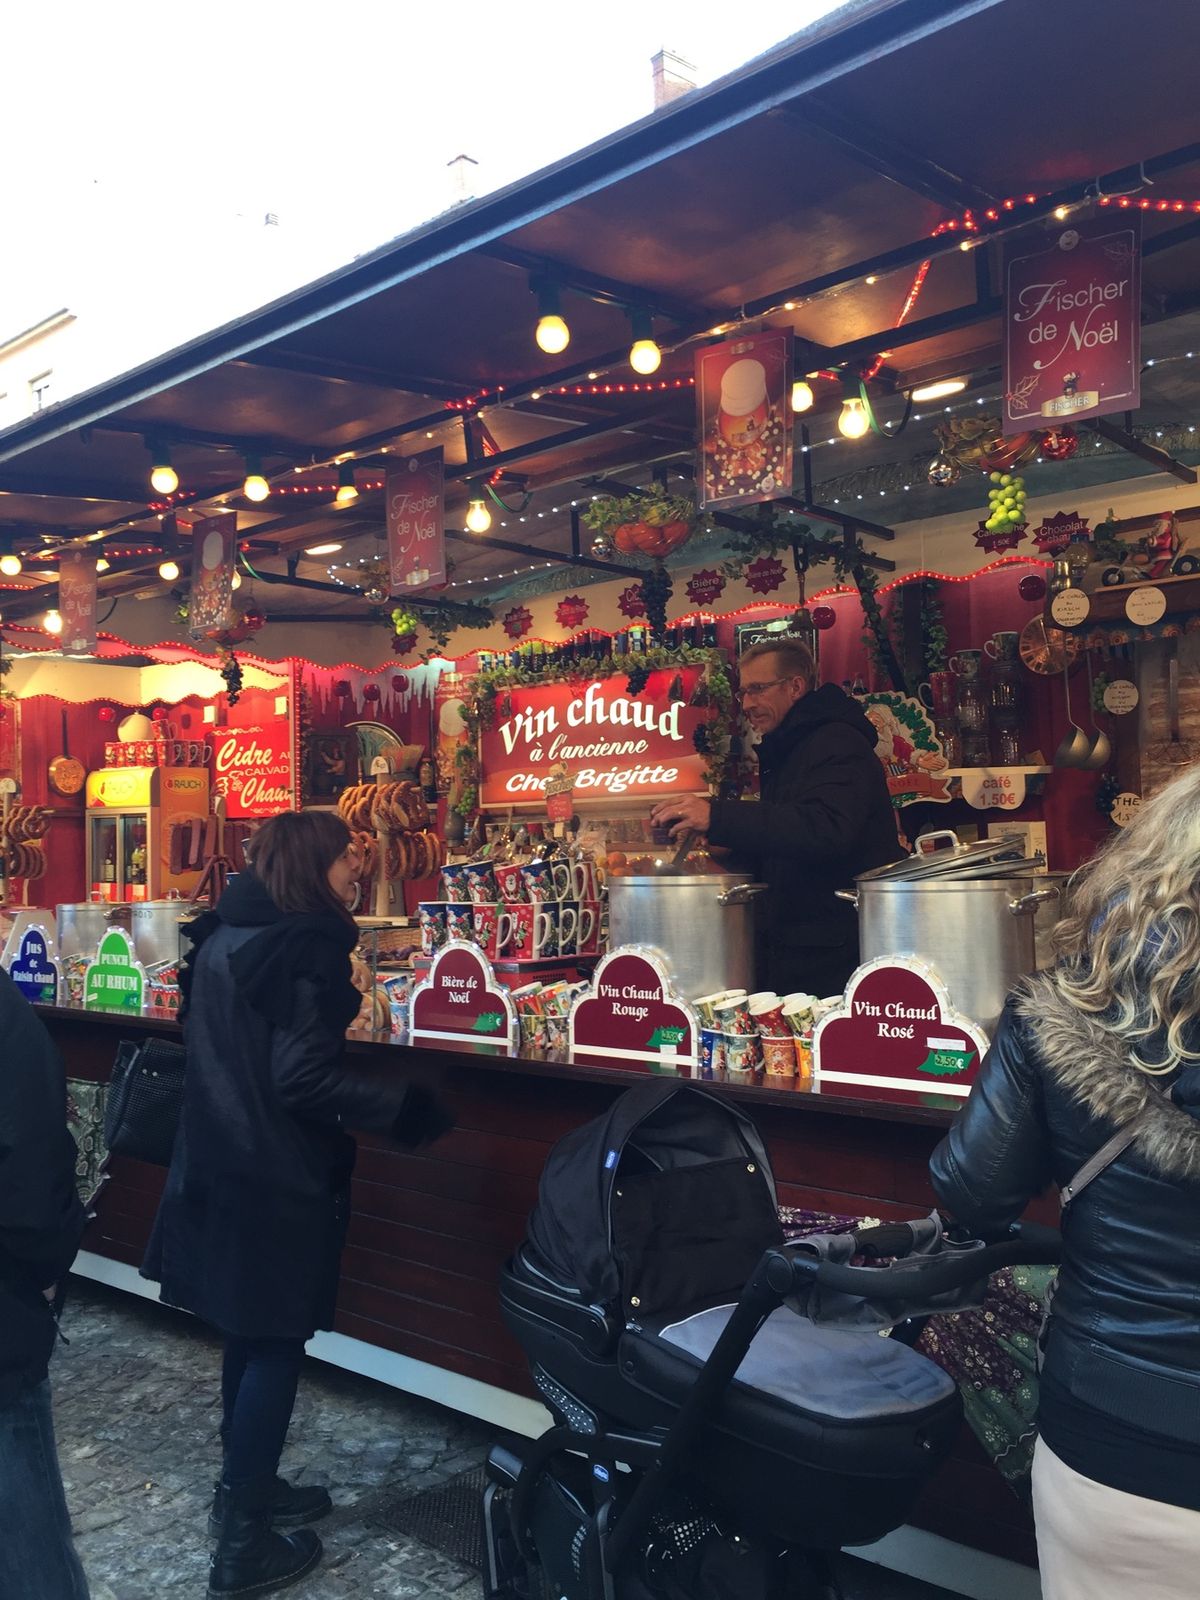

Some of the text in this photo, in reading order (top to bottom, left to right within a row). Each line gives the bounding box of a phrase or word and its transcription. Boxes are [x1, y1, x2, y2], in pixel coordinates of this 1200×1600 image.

[1014, 279, 1129, 322] Fischer
[1028, 303, 1119, 370] de Noël
[391, 493, 439, 520] Fischer
[397, 510, 436, 553] de Noël
[1039, 520, 1084, 536] Chocolat
[1047, 531, 1078, 544] chau
[499, 682, 687, 756] Vin chaud
[216, 738, 273, 772] Cidre
[529, 732, 649, 762] à l'ancienne
[244, 765, 290, 777] CALVAD
[505, 763, 680, 793] Che Brigitte
[174, 779, 201, 789] RAUCH
[982, 775, 1012, 789] café
[980, 792, 1016, 806] 1.50€
[1113, 796, 1140, 806] THE
[25, 941, 43, 956] Jus
[101, 953, 129, 966] PUNCH
[34, 971, 55, 984] chaud
[91, 973, 138, 991] AU RHUM
[441, 975, 478, 989] Bière de
[448, 990, 470, 1005] Noël
[600, 984, 662, 1001] Vin Chaud
[611, 1002, 649, 1022] Rouge
[854, 1001, 939, 1021] Vin Chaud
[877, 1022, 916, 1040] Rosé
